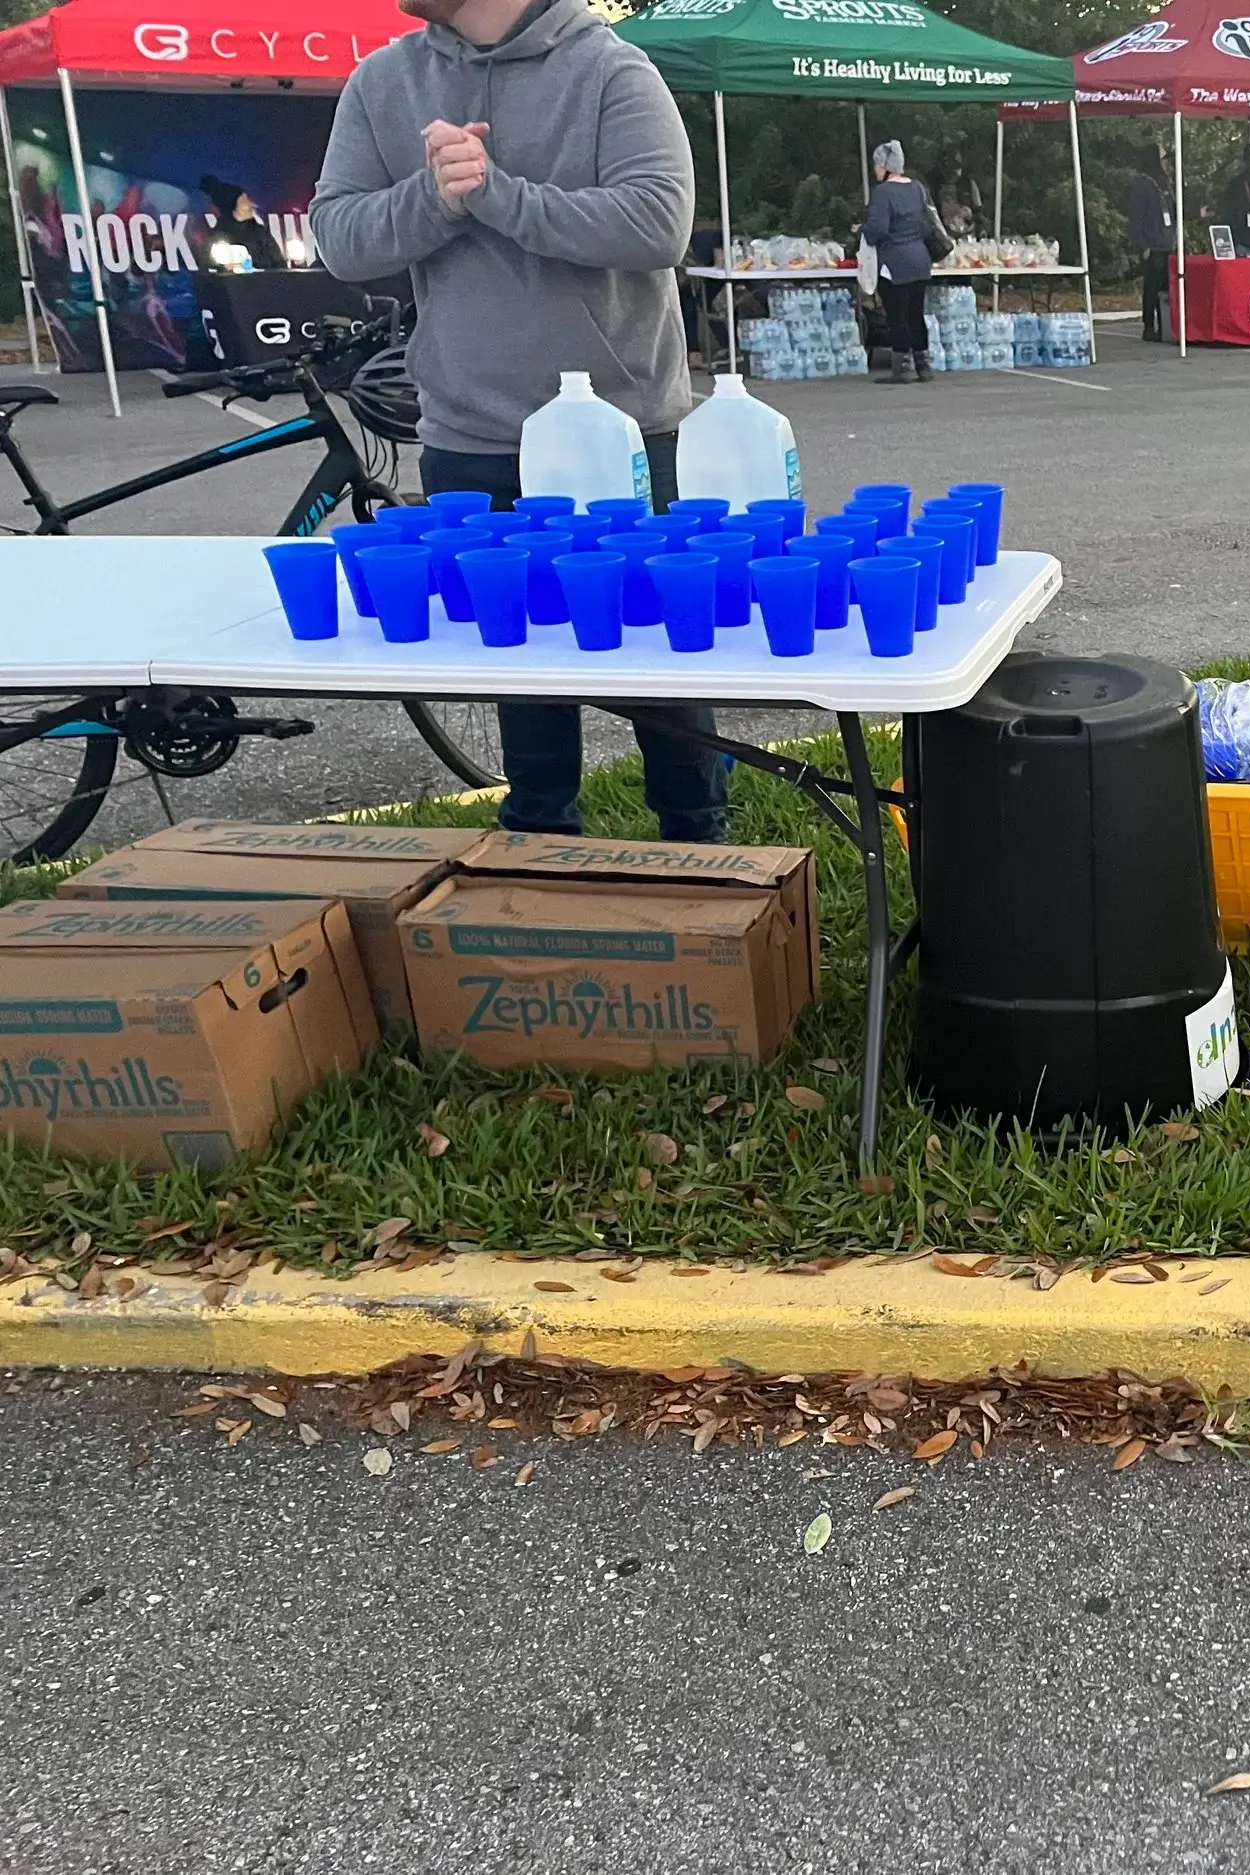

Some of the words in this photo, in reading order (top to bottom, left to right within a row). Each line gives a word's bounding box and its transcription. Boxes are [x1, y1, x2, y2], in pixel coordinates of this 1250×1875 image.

[773, 0, 925, 21] SPROUTS
[211, 29, 400, 63] CYCL
[792, 57, 820, 77] It's
[824, 59, 891, 83] Healthy
[894, 61, 947, 86] Living
[948, 65, 973, 83] for
[1190, 88, 1218, 103] The
[524, 845, 766, 871] Zephyrhills
[8, 911, 264, 938] Zephyrhills
[457, 933, 490, 947] 100%
[492, 934, 541, 949] NATURAL
[632, 940, 667, 953] WATER
[243, 963, 262, 988] 6
[458, 976, 716, 1038] Zephyrhills
[0, 1057, 183, 1121] hyrhills
